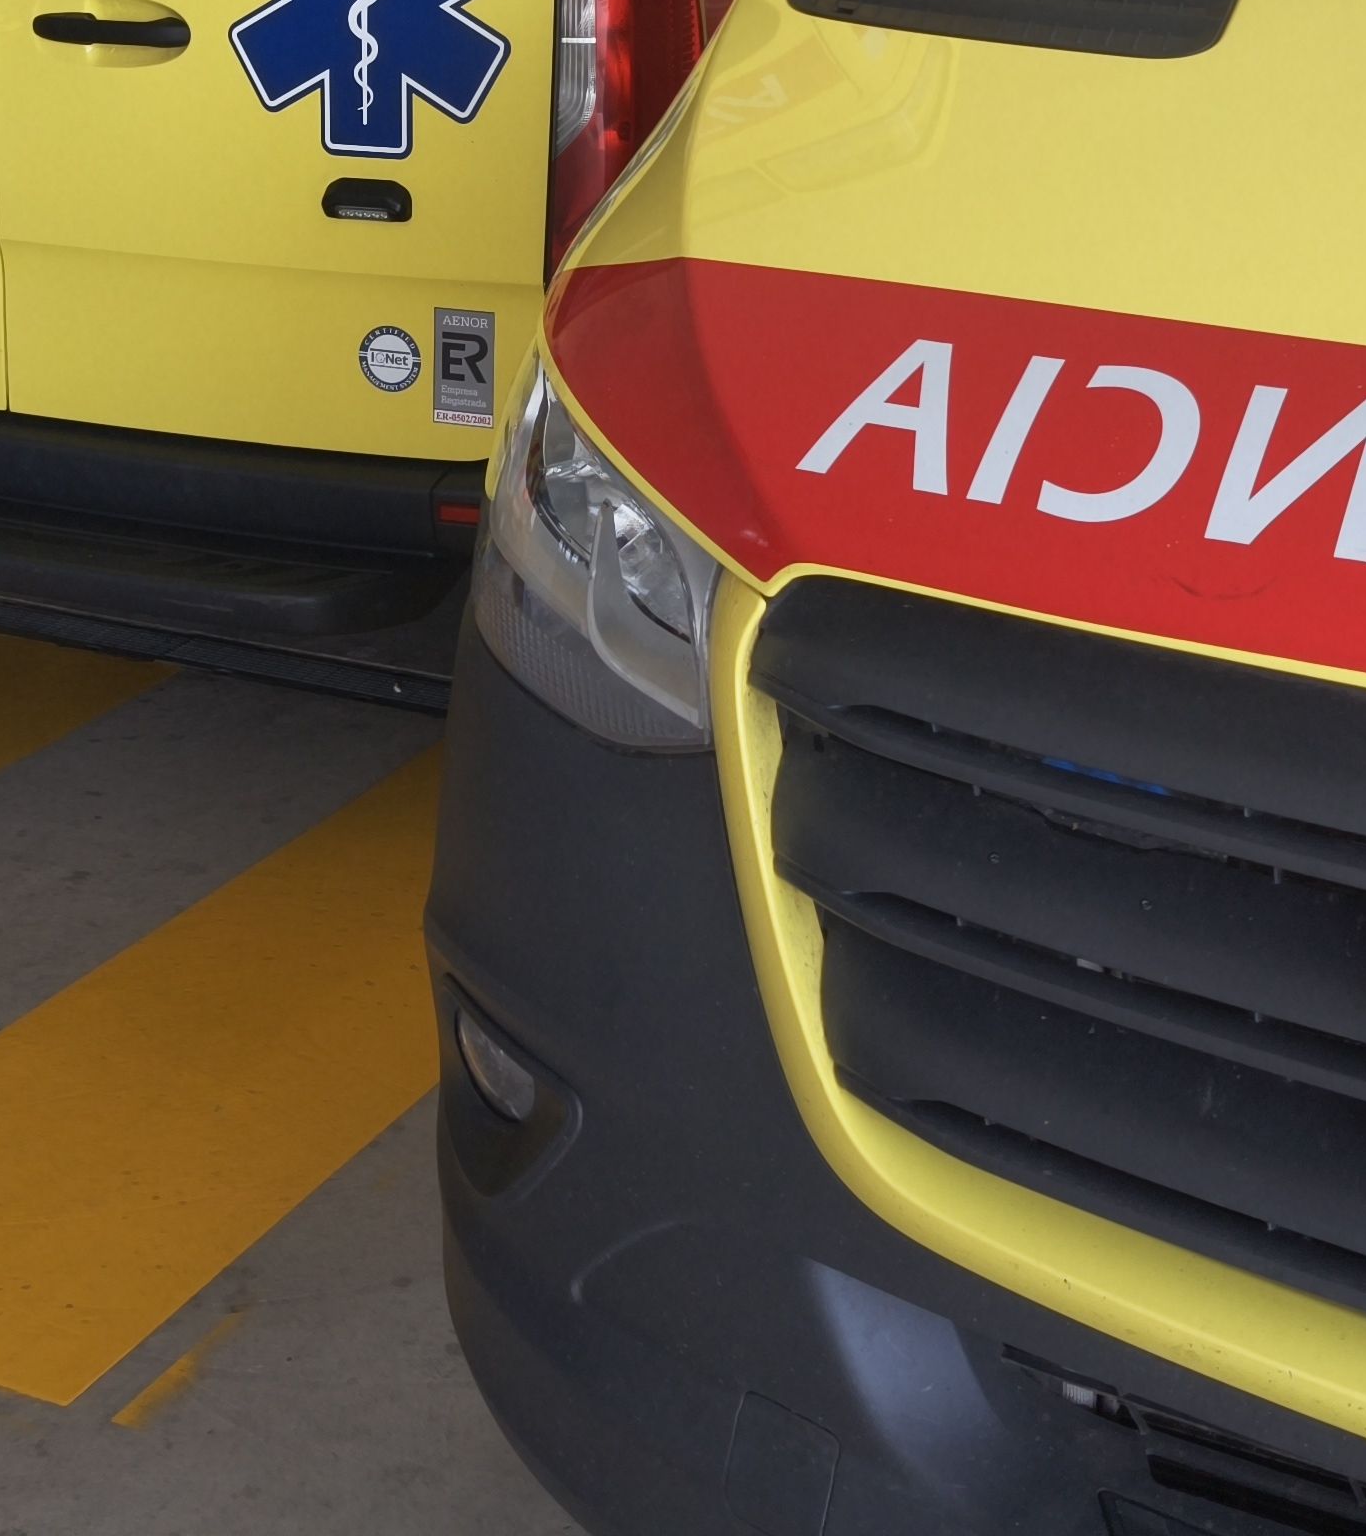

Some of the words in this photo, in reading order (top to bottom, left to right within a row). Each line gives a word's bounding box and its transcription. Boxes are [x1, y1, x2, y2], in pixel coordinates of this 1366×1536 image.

[442, 315, 488, 329] AENOR
[365, 327, 416, 350] CERTIFIED
[441, 384, 478, 397] Empresa
[441, 395, 487, 408] Registrada
